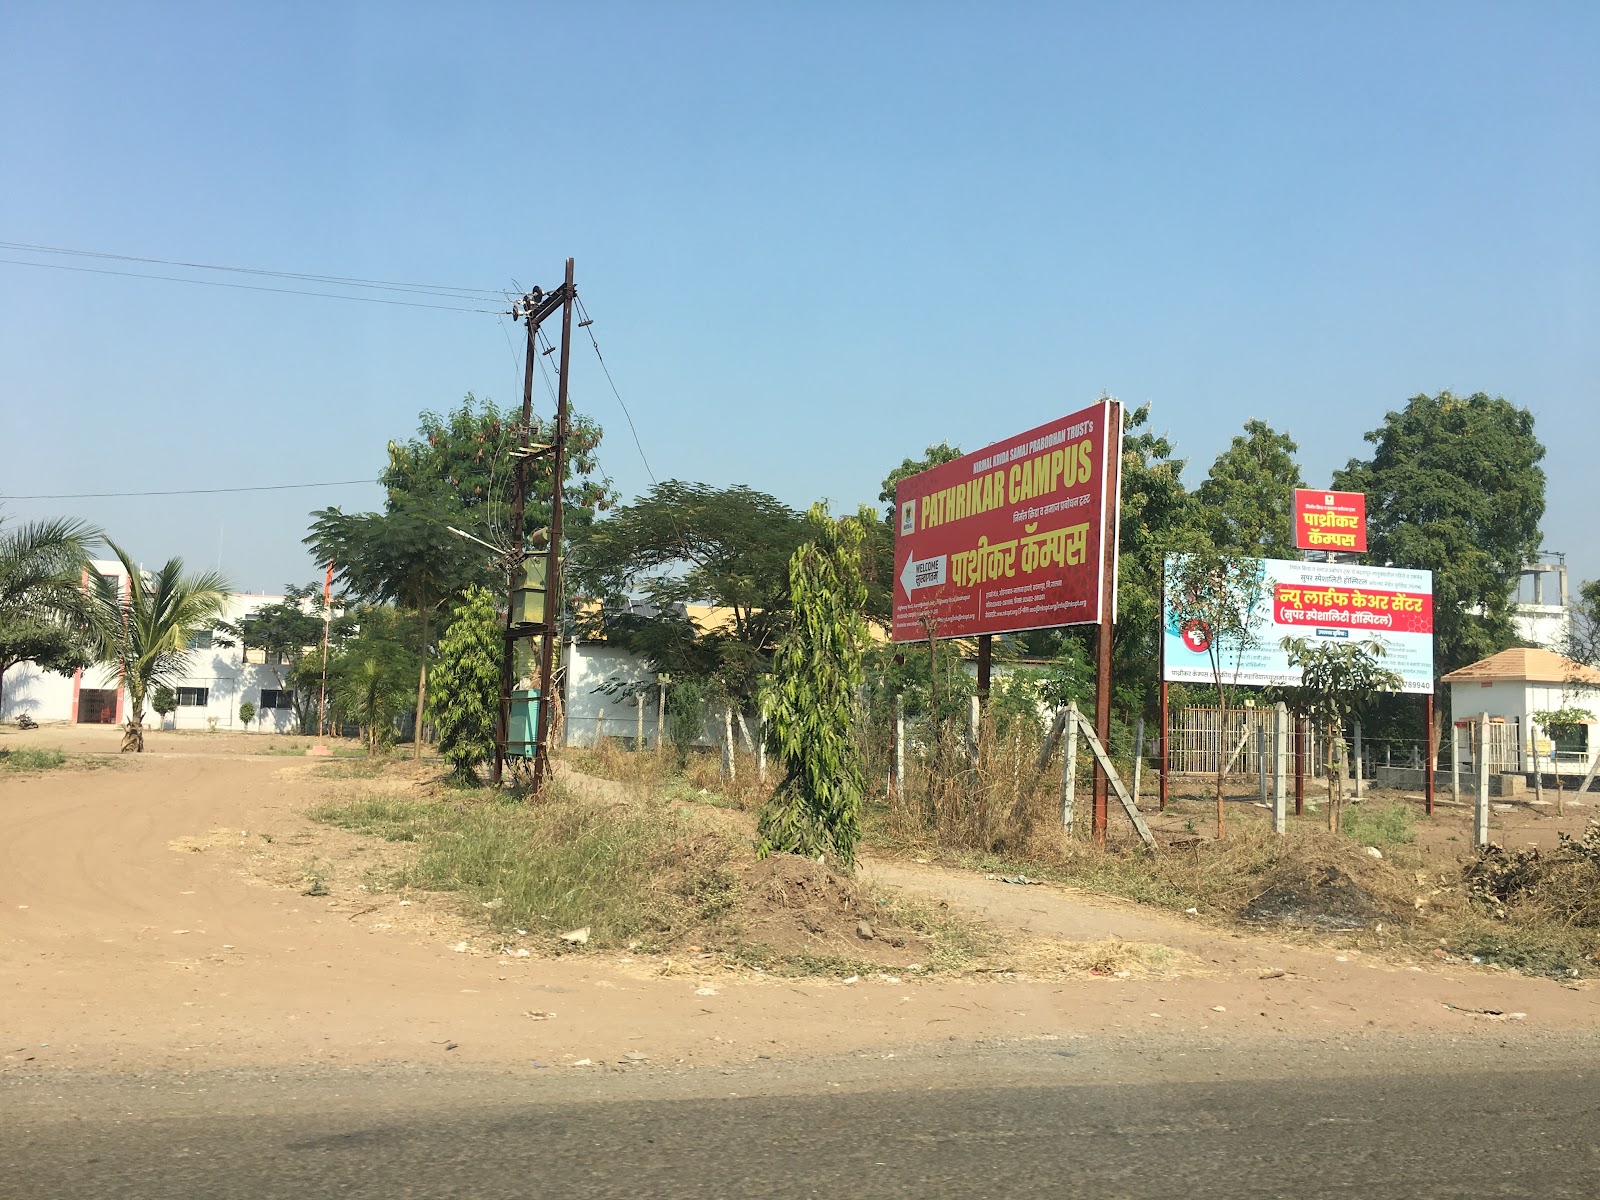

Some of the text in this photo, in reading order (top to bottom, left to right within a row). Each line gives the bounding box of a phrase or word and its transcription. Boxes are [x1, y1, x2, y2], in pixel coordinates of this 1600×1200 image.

[1010, 443, 1029, 461] SAMAJ
[1029, 428, 1066, 454] PRABODHAN
[921, 439, 1093, 530] PATHRIKAR CAMPUS
[1303, 511, 1359, 528] पाथ्रीकर
[1307, 528, 1356, 547] कॅम्पस
[951, 522, 1090, 587] पाथ्रीकर कॅम्पस
[915, 560, 939, 573] WELCOME
[1300, 574, 1313, 583] सुपर
[1279, 587, 1423, 612] न्यू लाईफ केअर सेंटर
[1280, 607, 1393, 627] (सुपर स्पेशालिटी हॉस्पिटल)
